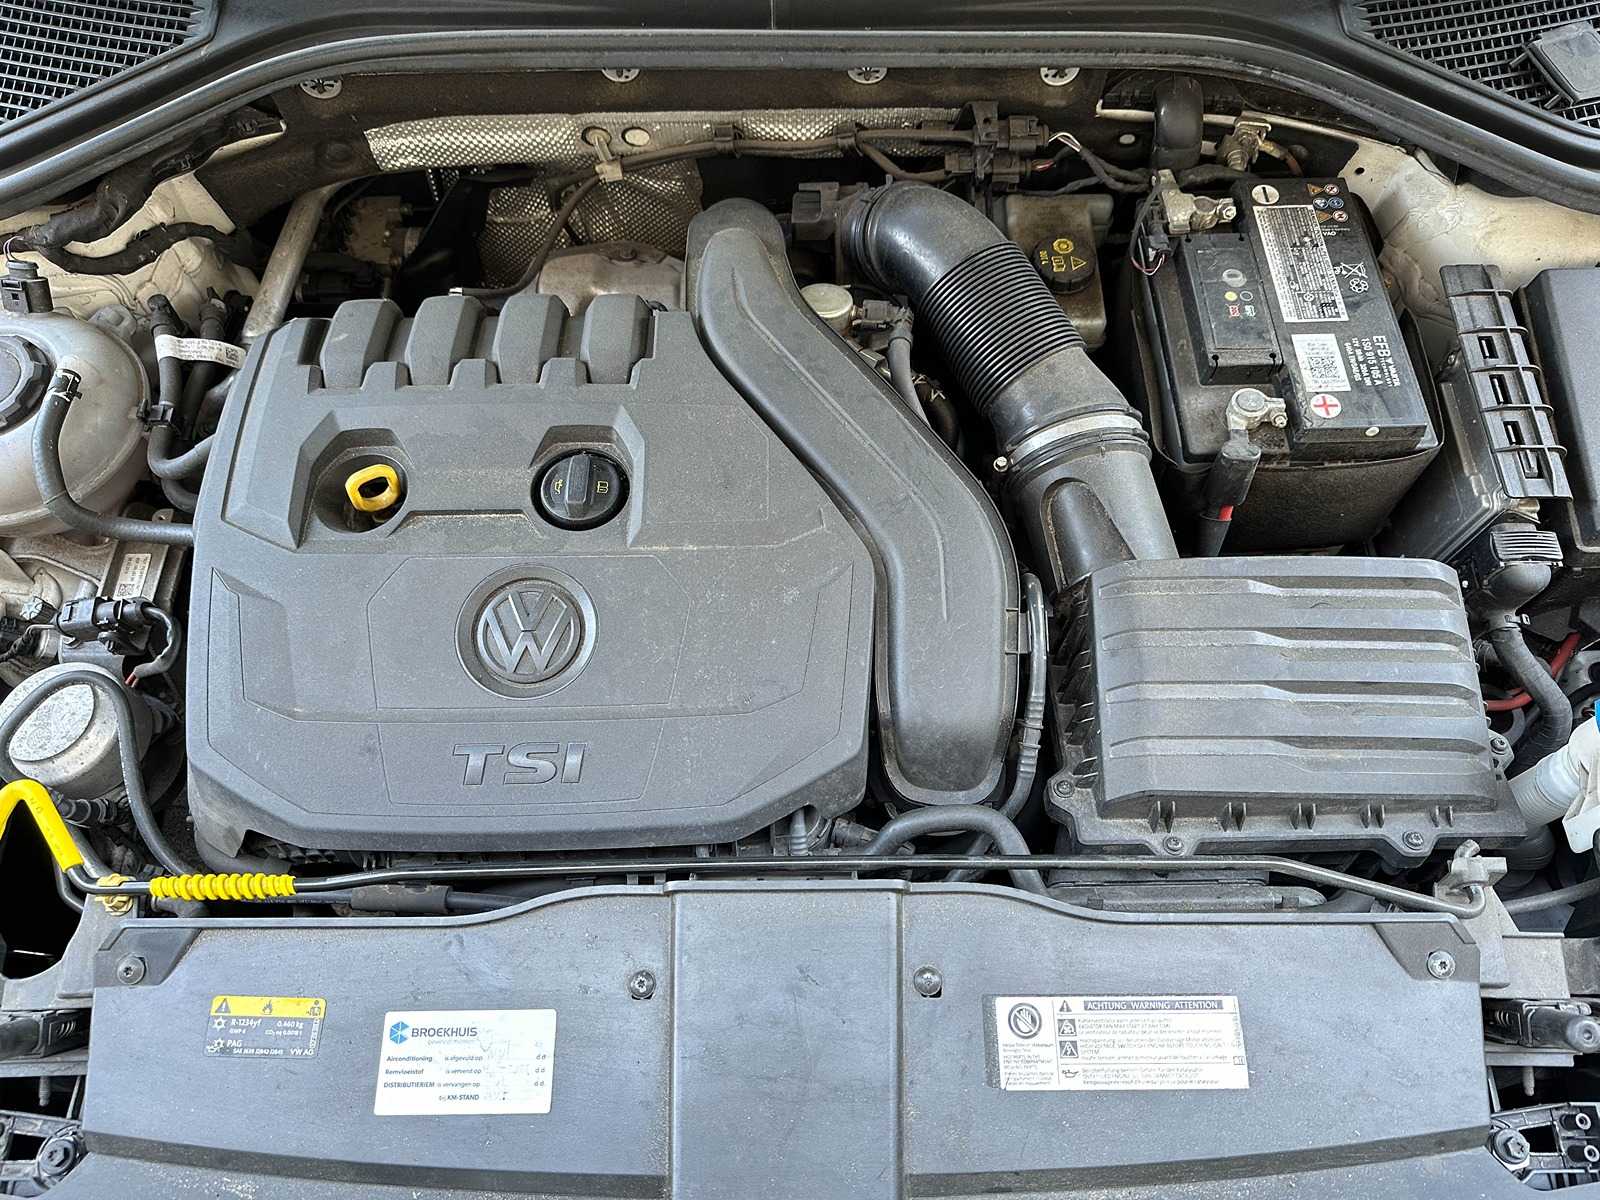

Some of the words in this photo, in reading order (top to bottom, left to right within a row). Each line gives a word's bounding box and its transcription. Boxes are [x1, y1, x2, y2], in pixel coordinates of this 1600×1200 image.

[1372, 335, 1391, 357] EFB
[1365, 351, 1377, 365] 915
[452, 742, 588, 786] TSI
[1087, 1001, 1128, 1010] ACHTUNG
[1131, 1001, 1171, 1010] WARNING
[1174, 1001, 1218, 1010] ATTENTION
[411, 1027, 478, 1038] BROEKHUIS
[226, 1040, 242, 1048] PAG
[303, 1048, 314, 1056] AG
